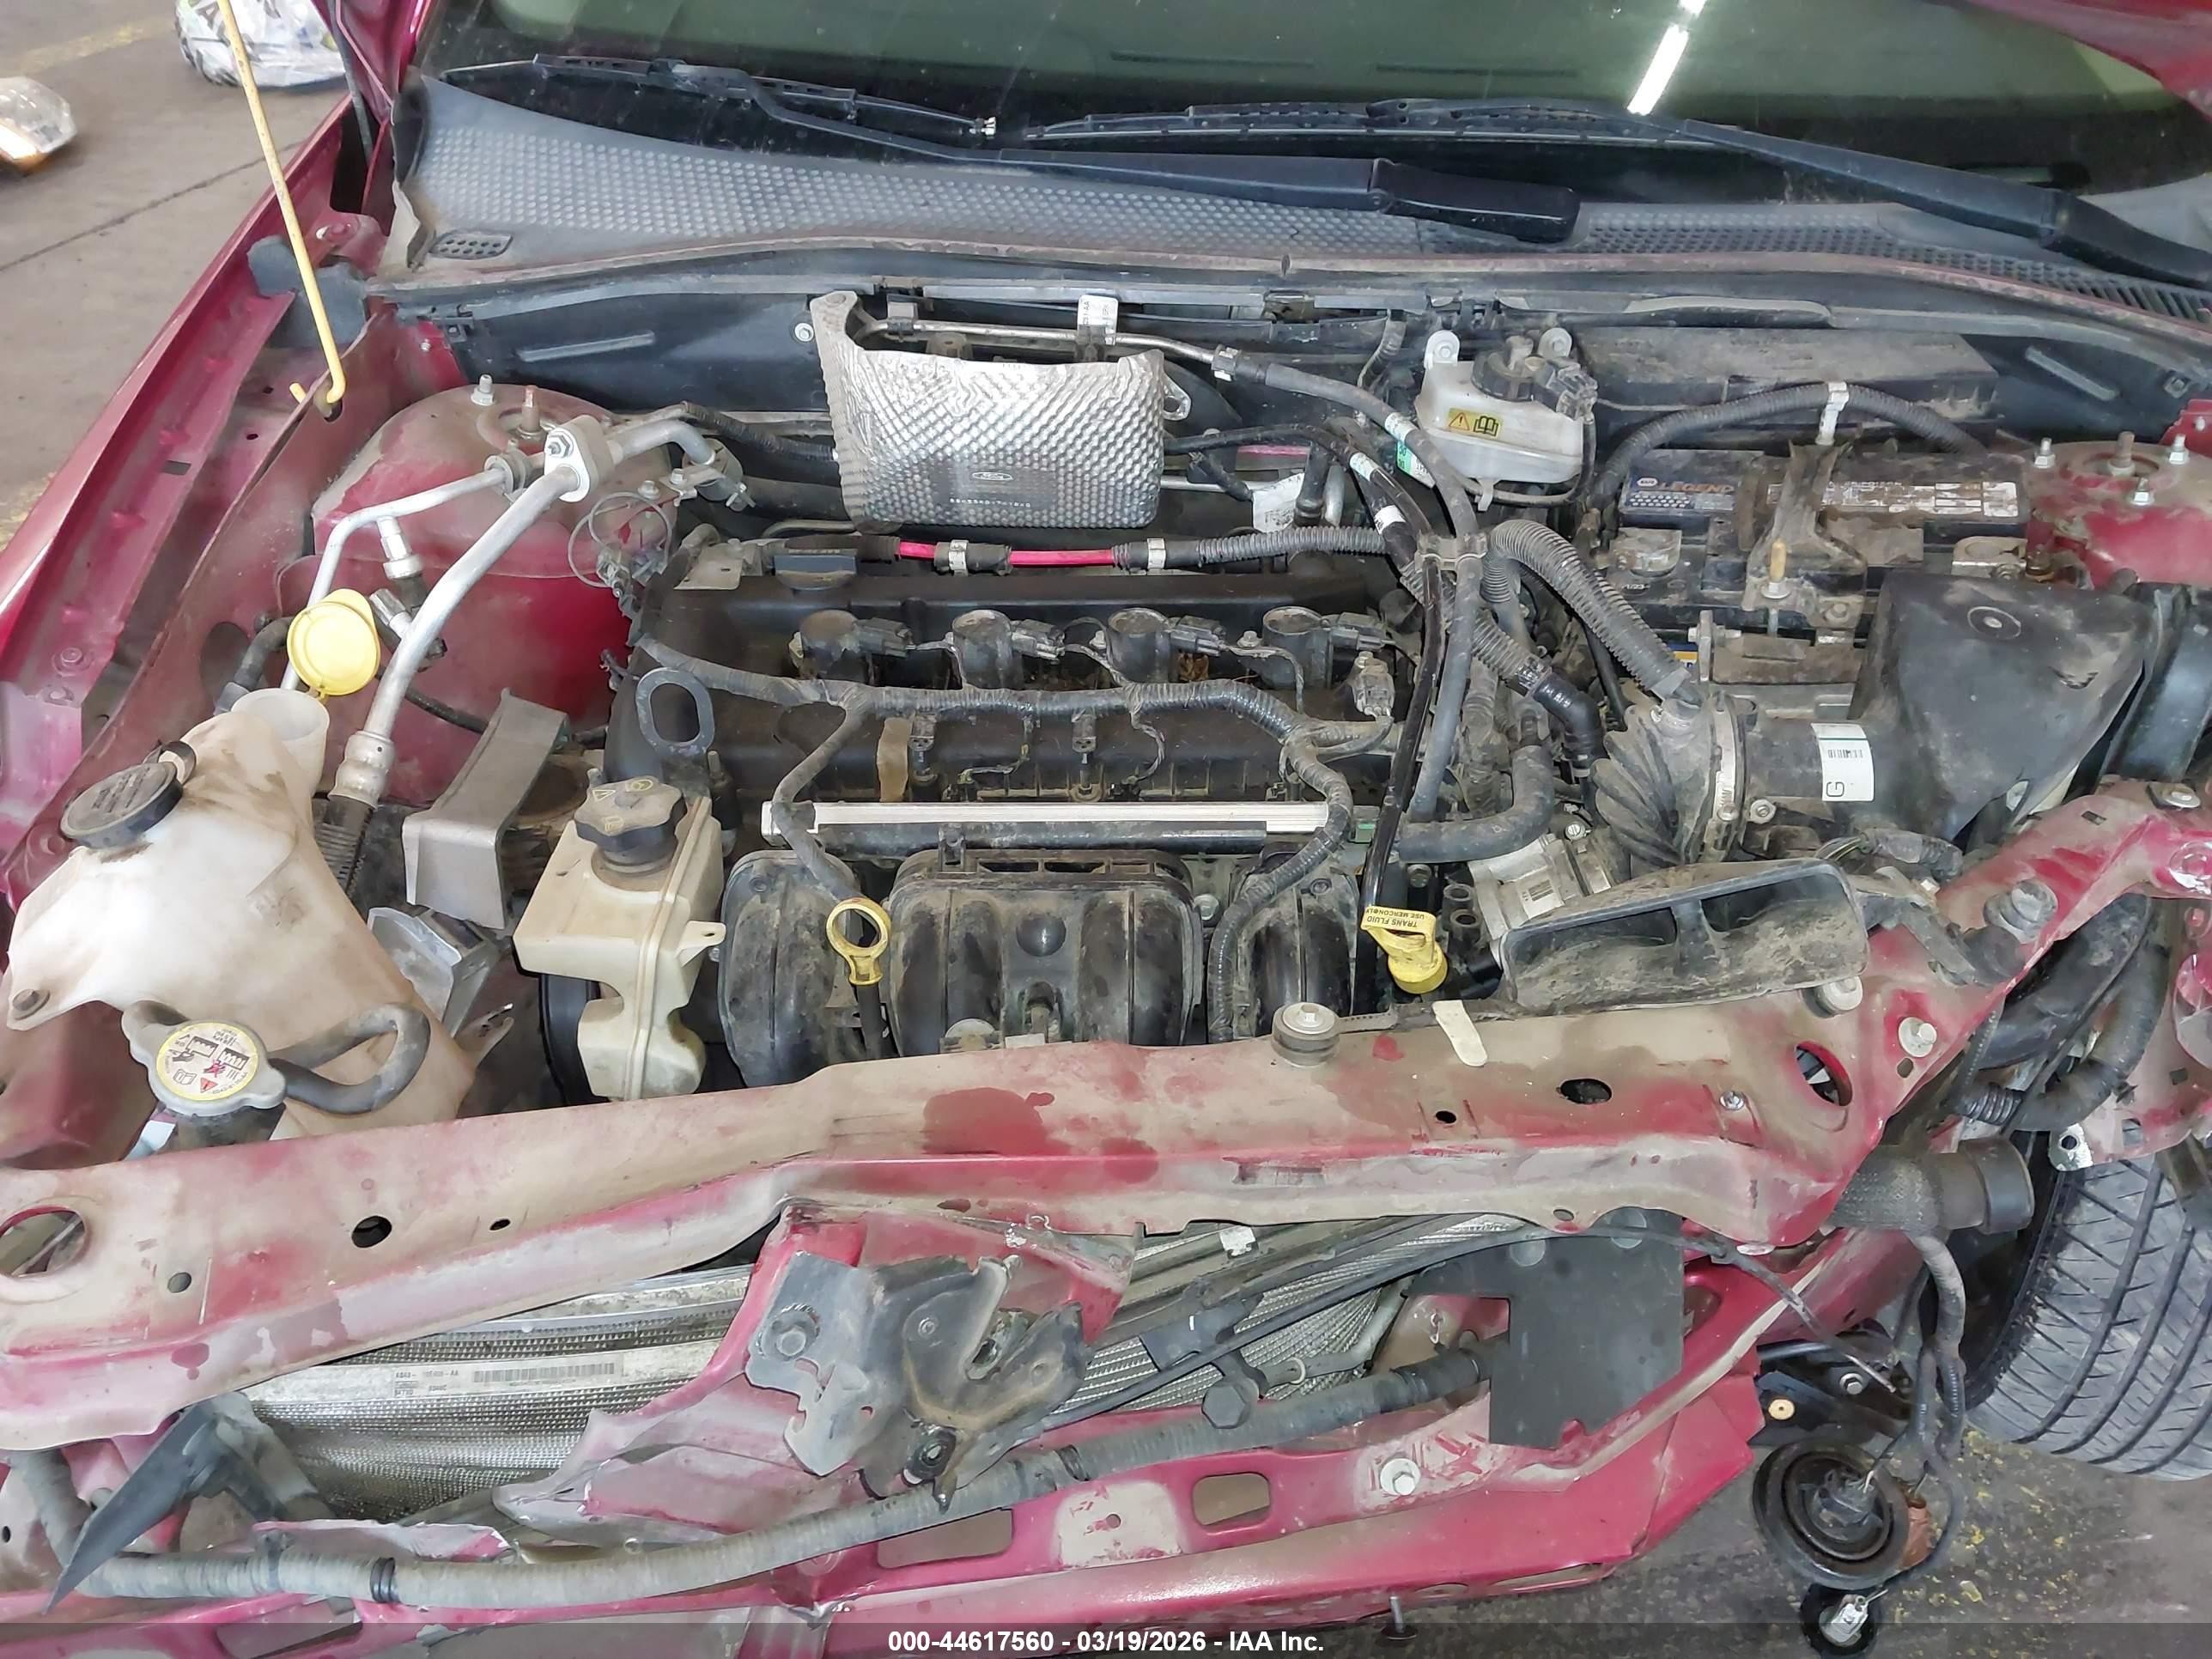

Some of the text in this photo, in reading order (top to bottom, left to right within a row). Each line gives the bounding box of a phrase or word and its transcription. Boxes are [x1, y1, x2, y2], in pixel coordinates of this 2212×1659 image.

[1658, 481, 1735, 493] LEGEND
[1826, 781, 1845, 797] G
[1366, 915, 1418, 928] TRANS FLUID
